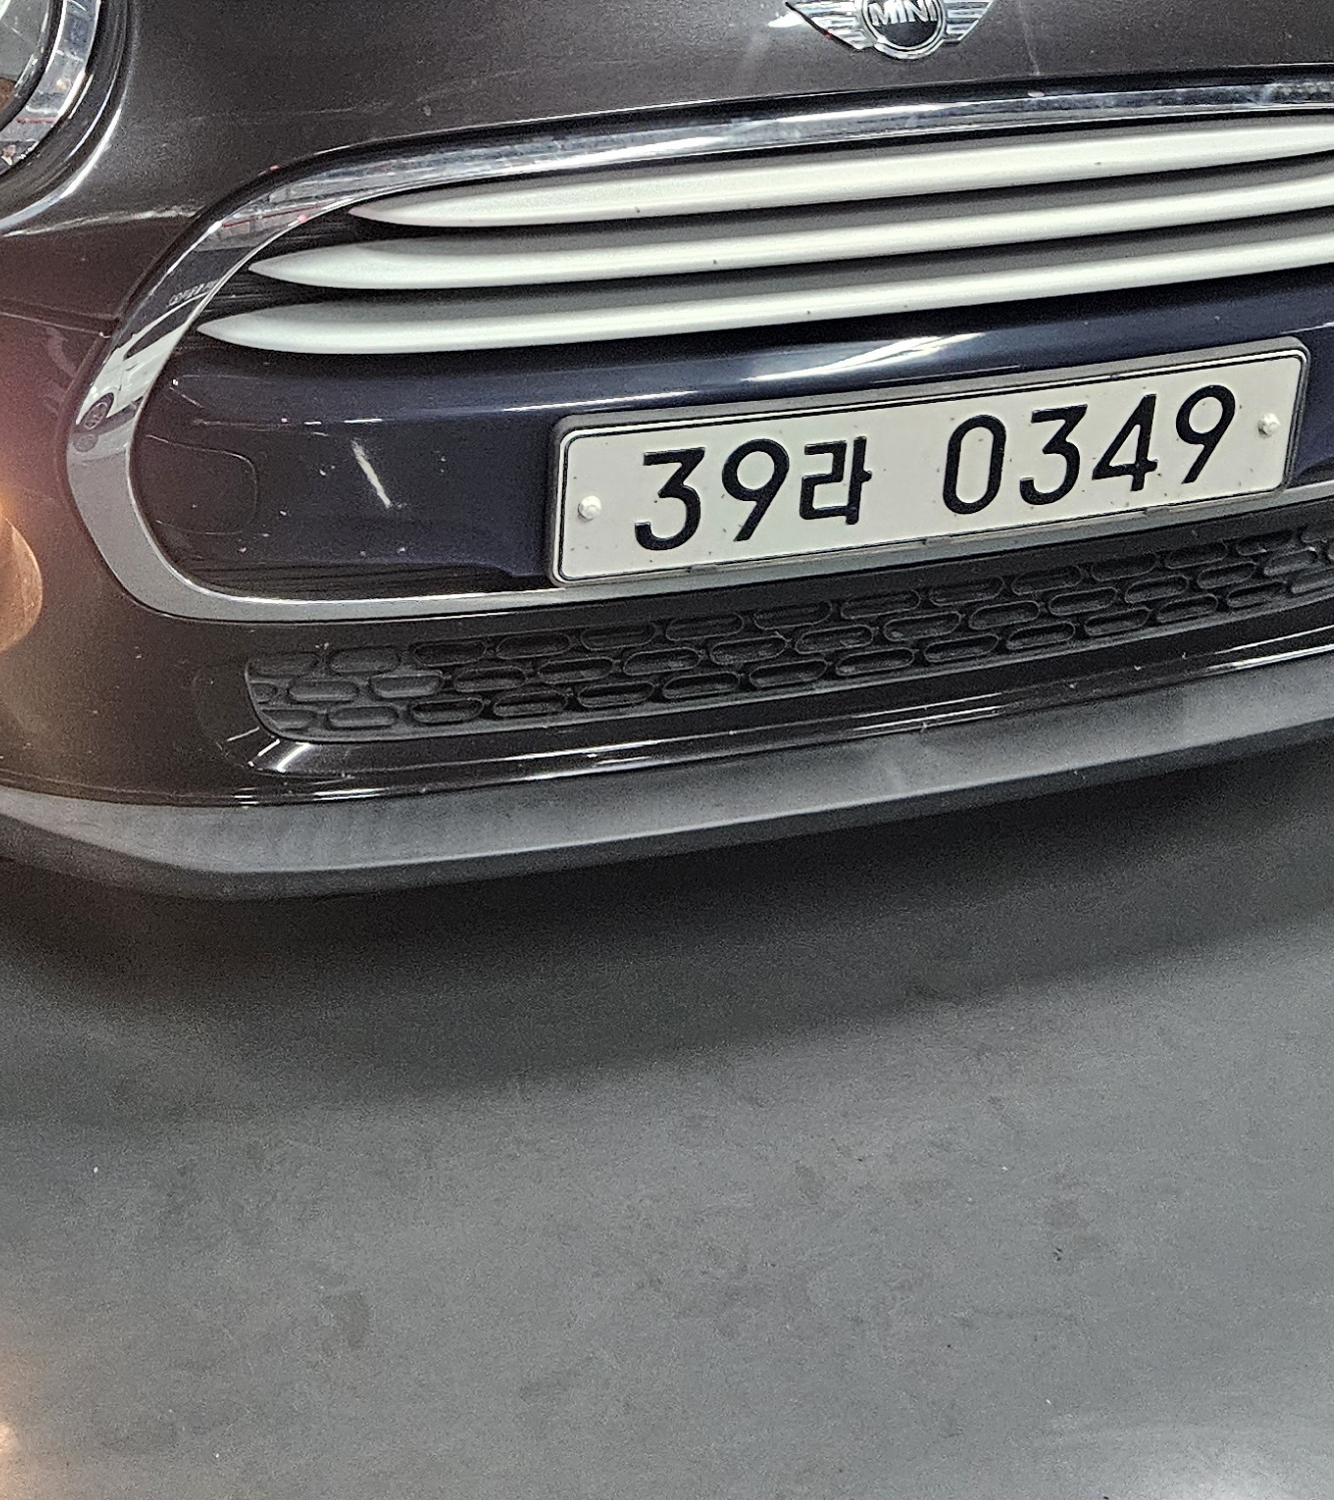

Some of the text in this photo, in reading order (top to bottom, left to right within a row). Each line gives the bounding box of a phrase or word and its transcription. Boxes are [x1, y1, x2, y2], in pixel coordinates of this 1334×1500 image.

[867, 0, 938, 28] MINI
[632, 384, 1238, 552] 39라 0349
